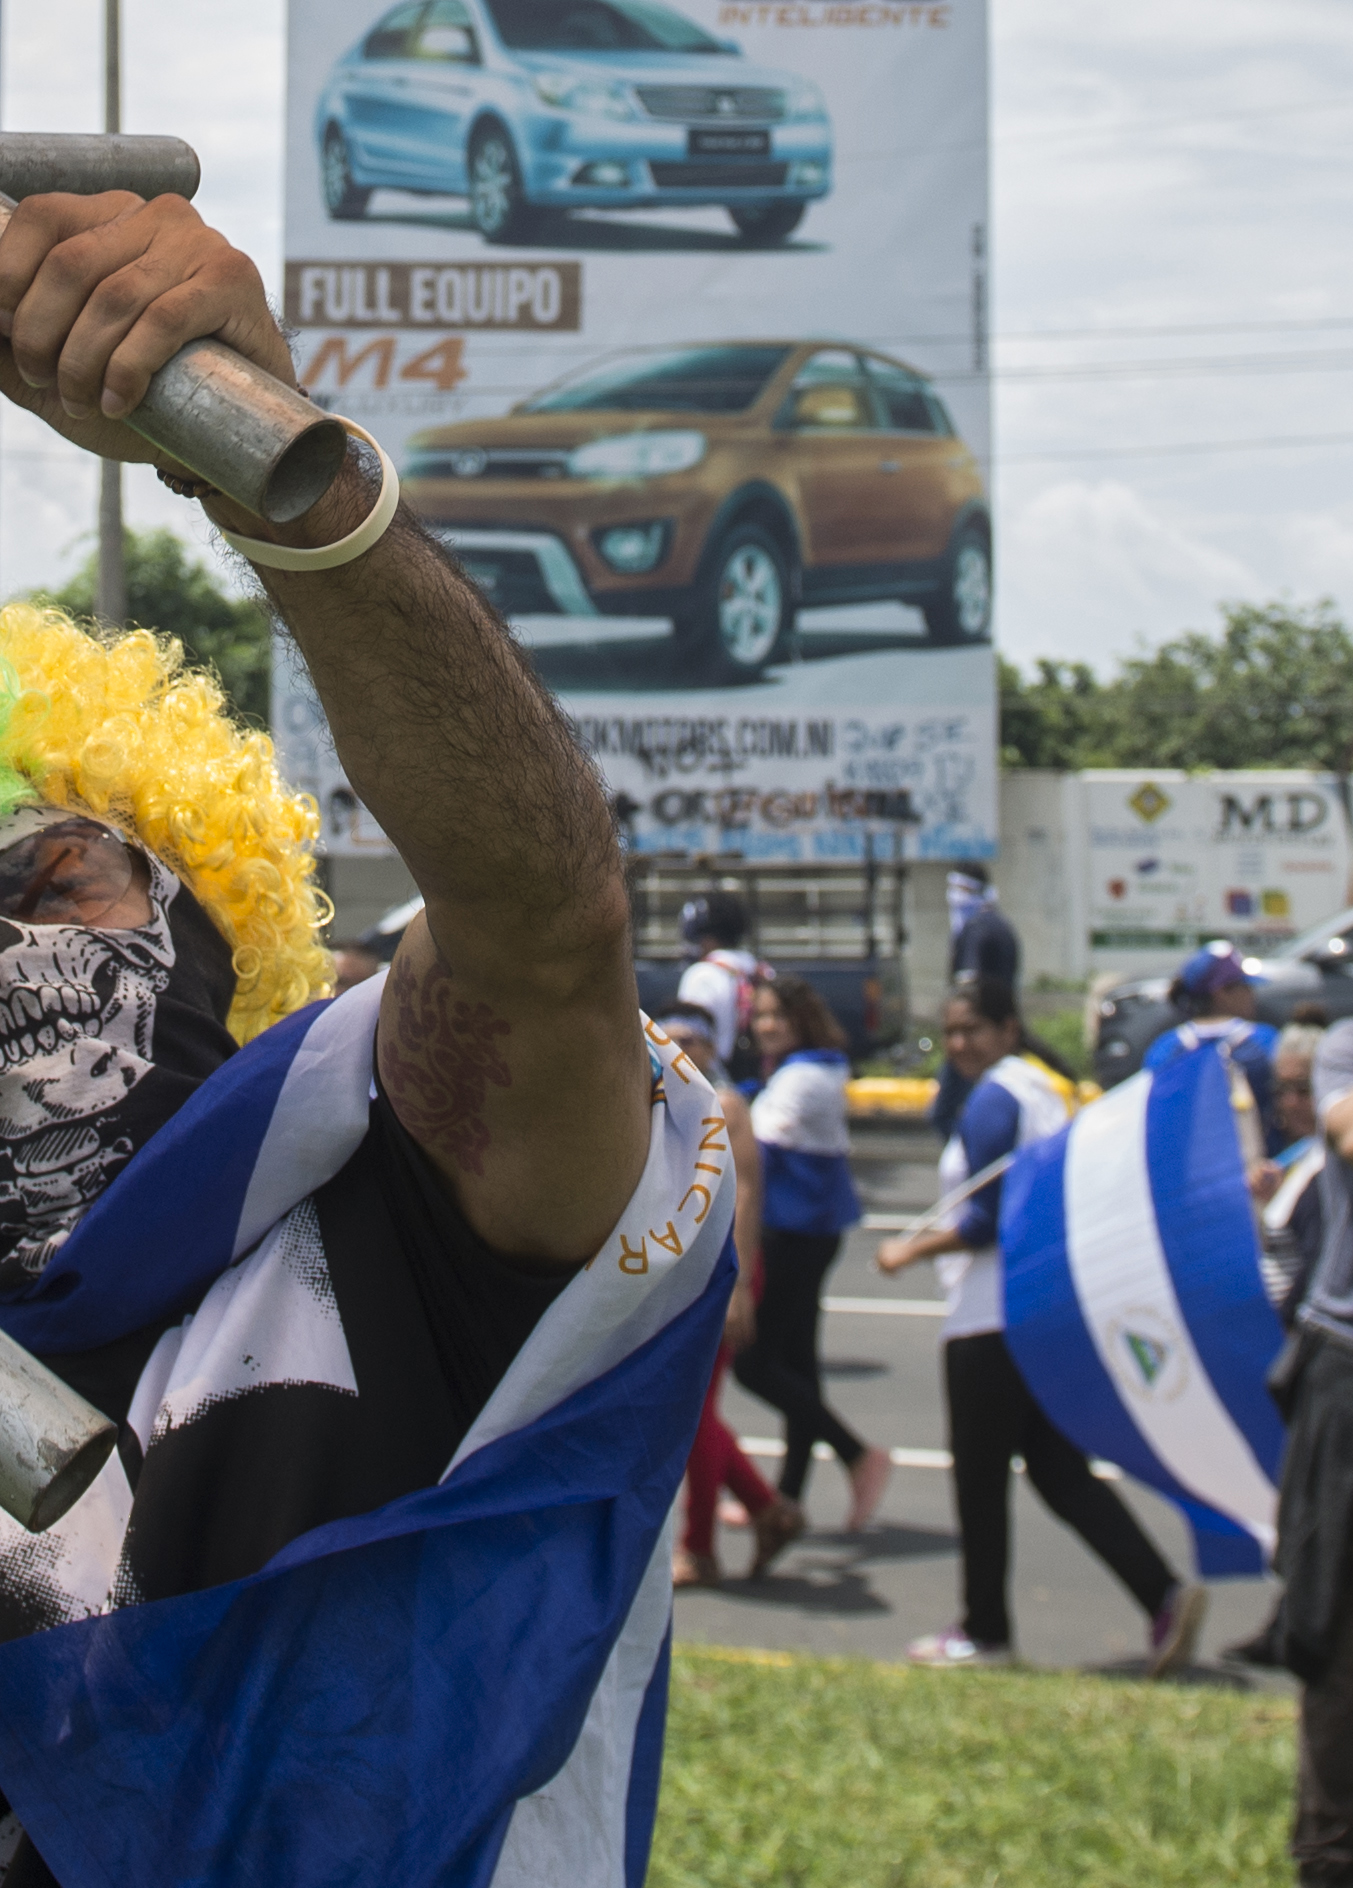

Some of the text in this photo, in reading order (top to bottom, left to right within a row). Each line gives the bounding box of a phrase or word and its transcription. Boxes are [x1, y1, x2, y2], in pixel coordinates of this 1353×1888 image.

[300, 266, 562, 324] FULL EQUIPO
[301, 336, 469, 392] M4
